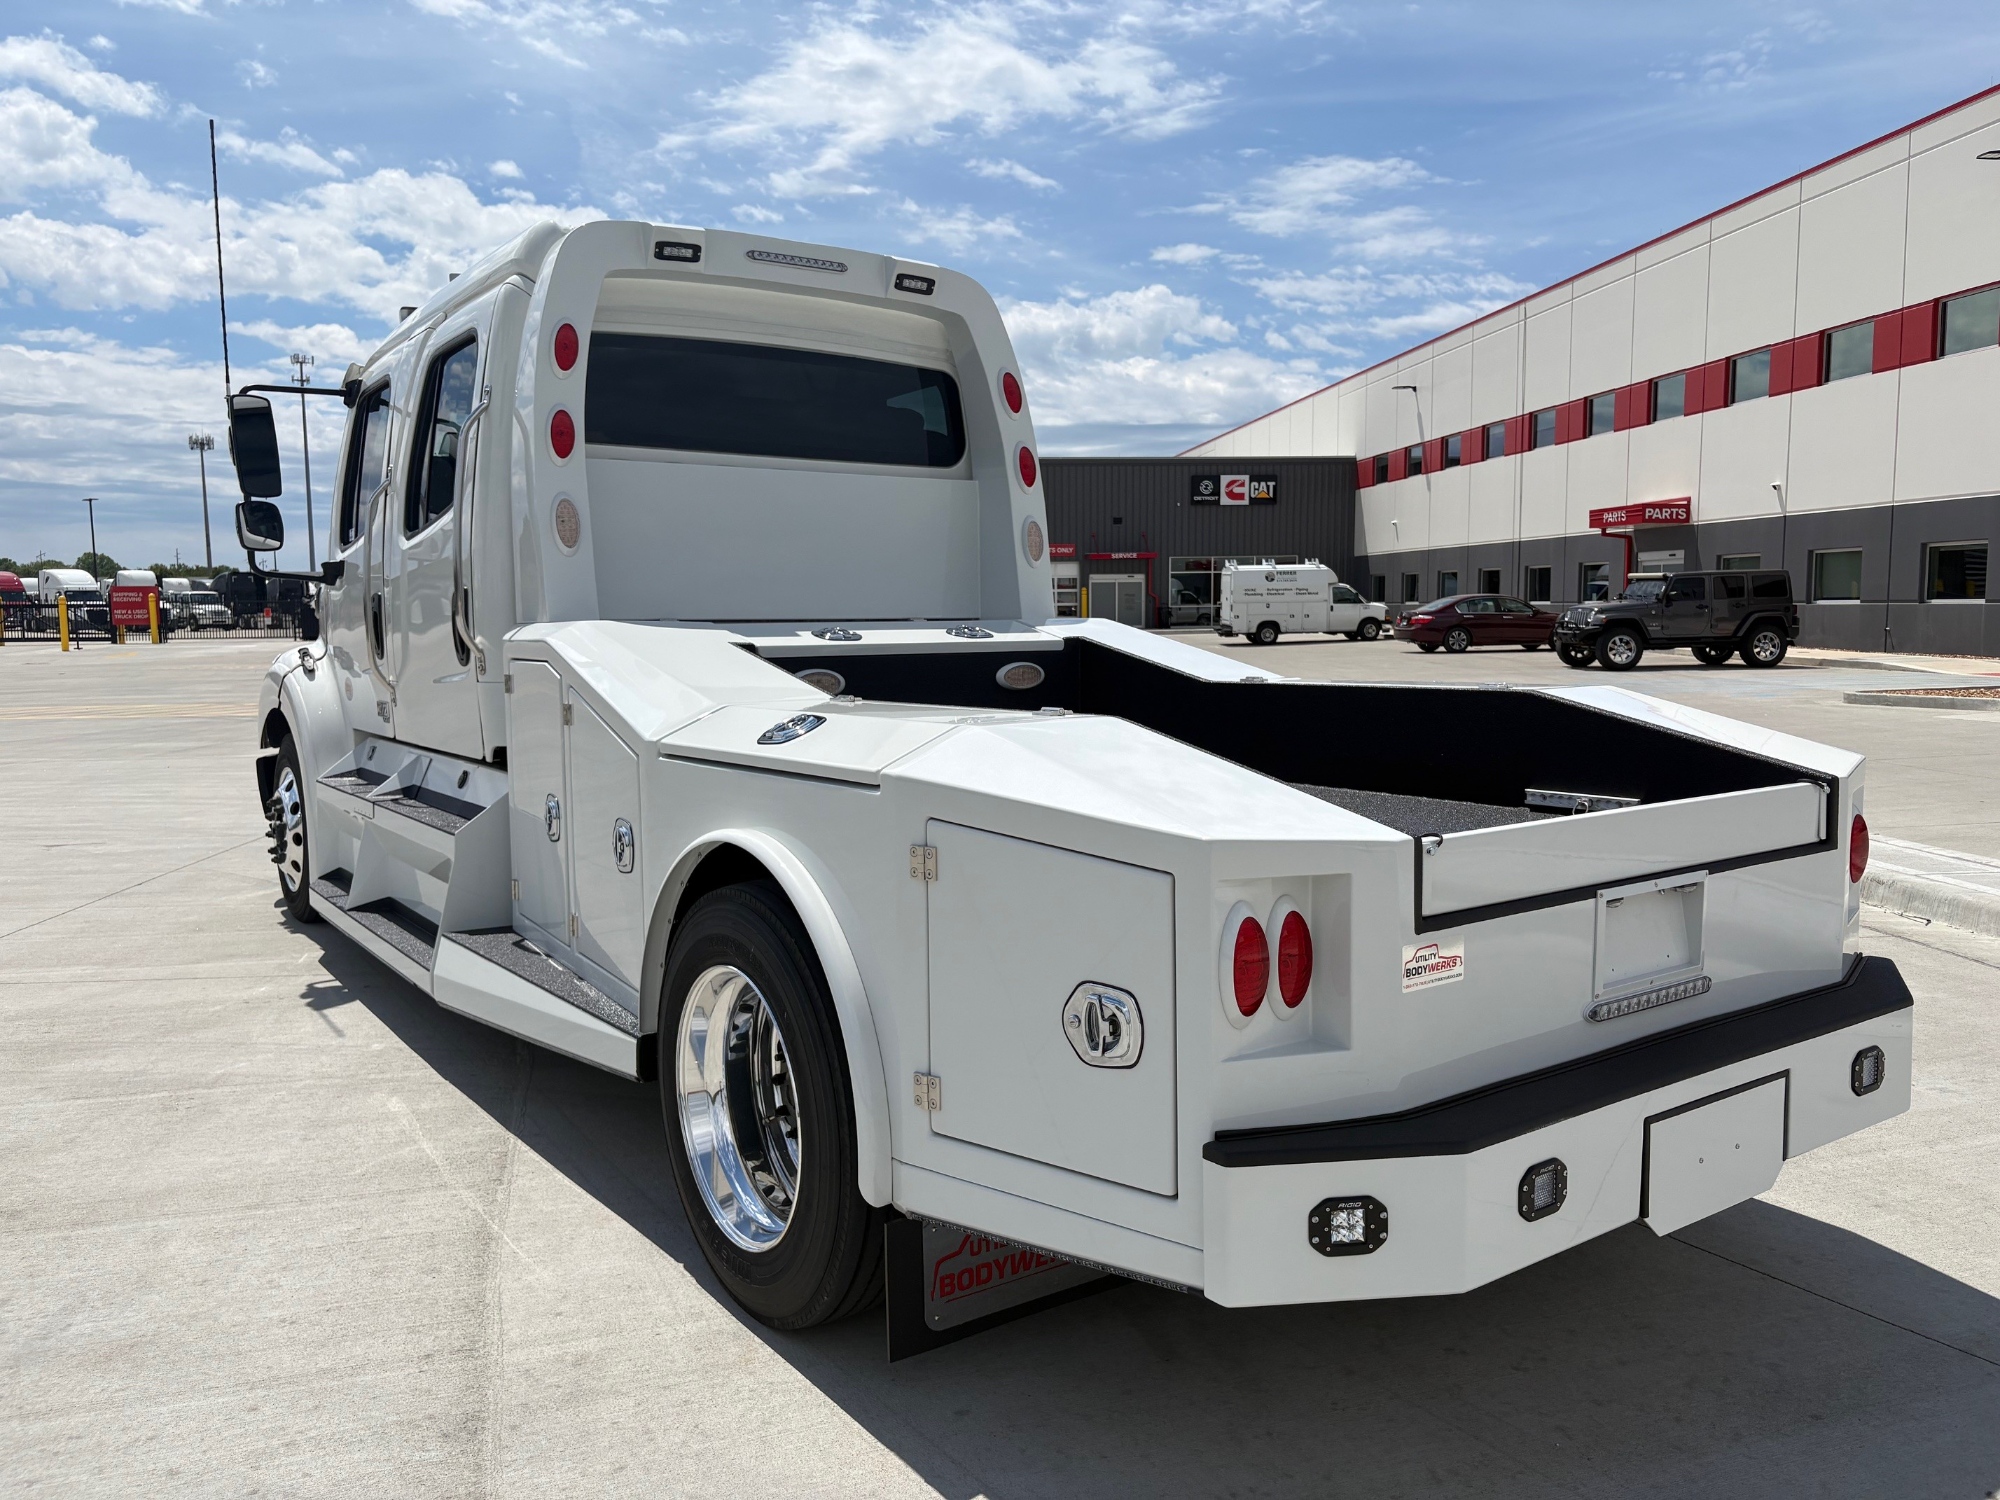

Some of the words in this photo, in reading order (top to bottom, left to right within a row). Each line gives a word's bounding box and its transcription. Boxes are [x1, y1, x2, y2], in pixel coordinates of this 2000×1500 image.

[1250, 482, 1276, 498] CAT
[1603, 511, 1627, 523] PARTS
[1645, 508, 1687, 520] PARTS
[1415, 952, 1437, 963] UTILITY
[1405, 958, 1457, 978] BODYWERKS
[939, 1249, 1057, 1298] BODYWE
